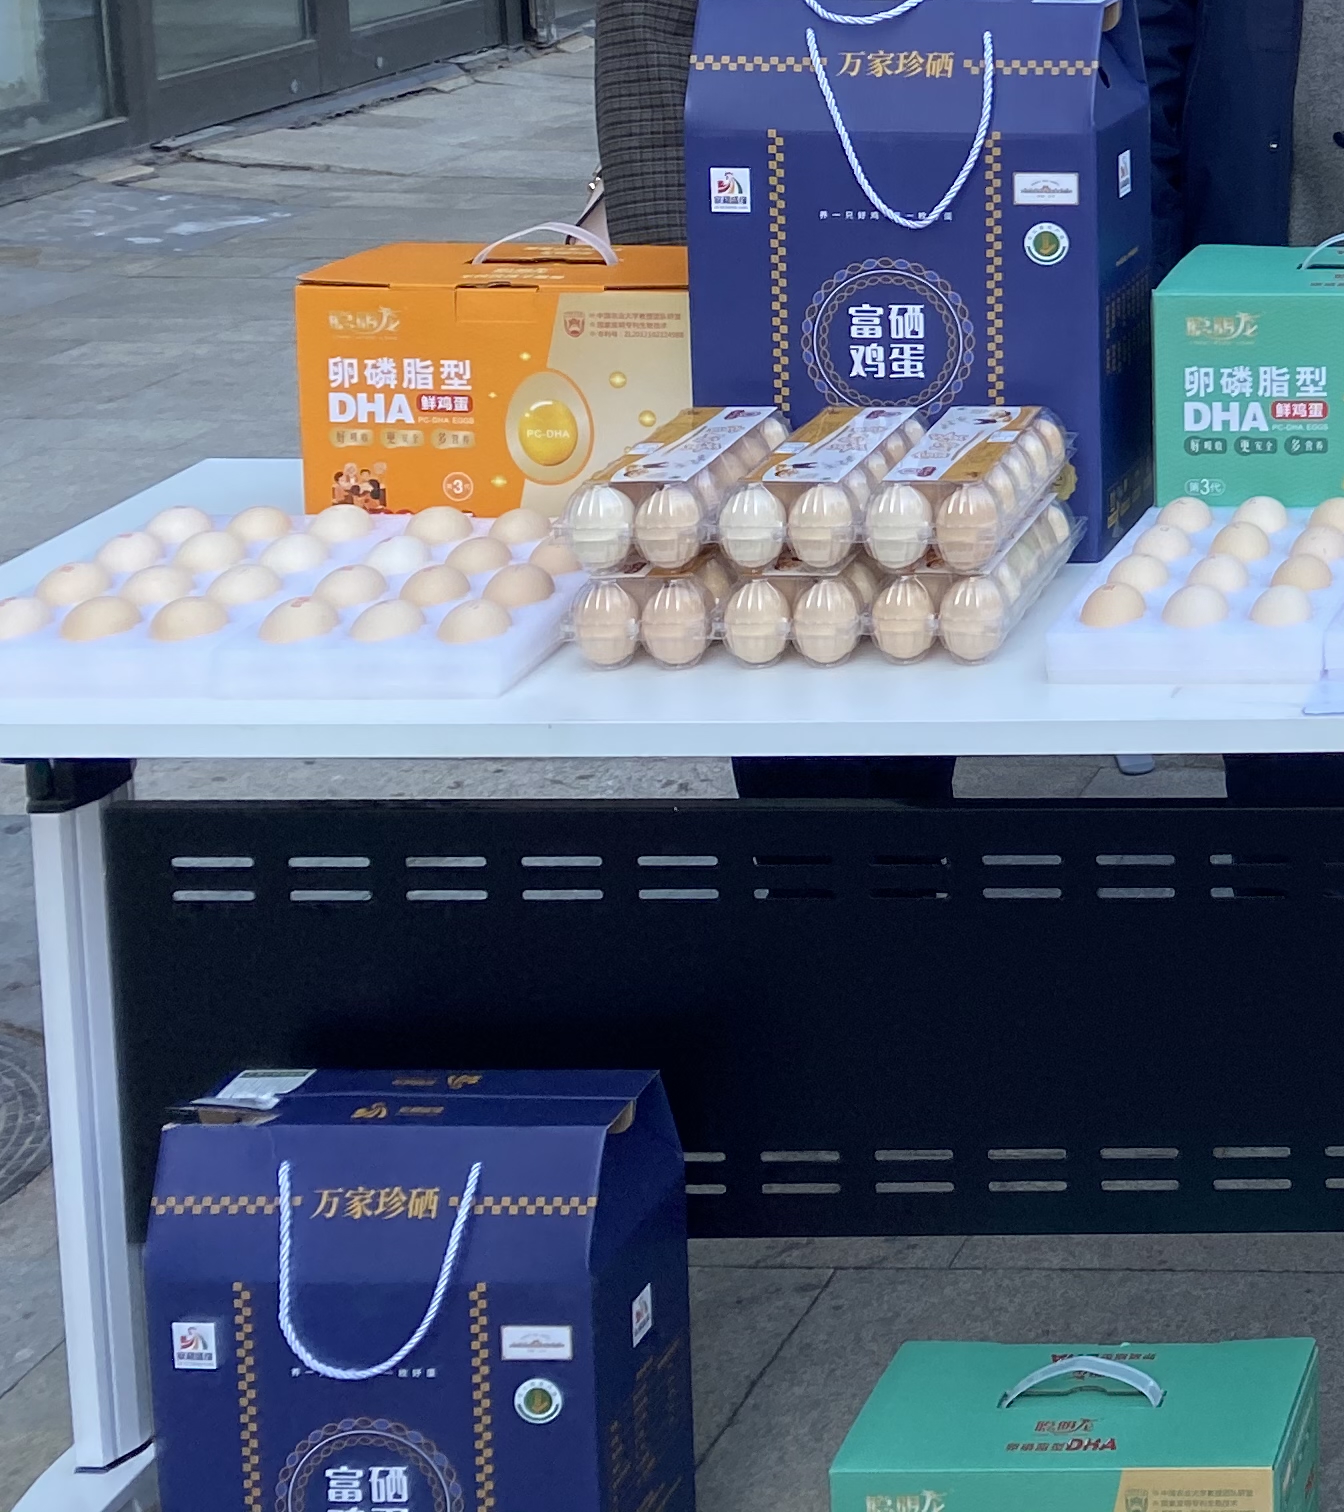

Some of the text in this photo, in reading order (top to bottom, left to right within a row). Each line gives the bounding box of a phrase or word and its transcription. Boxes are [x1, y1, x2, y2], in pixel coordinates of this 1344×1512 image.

[836, 51, 954, 79] 万家珍硒
[848, 303, 925, 340] 富硒
[328, 357, 472, 391] 卵磷脂型
[848, 343, 926, 379] 鸡蛋
[1184, 366, 1327, 398] 卵磷脂型
[328, 392, 415, 424] DHA
[420, 395, 468, 411] 鲜鸡蛋
[1183, 401, 1269, 432] DHA
[1275, 403, 1324, 418] 鲜鸡蛋
[526, 429, 570, 439] PC-DHA
[310, 1187, 440, 1221] 万家珍硒
[325, 1466, 408, 1503] 富硒
